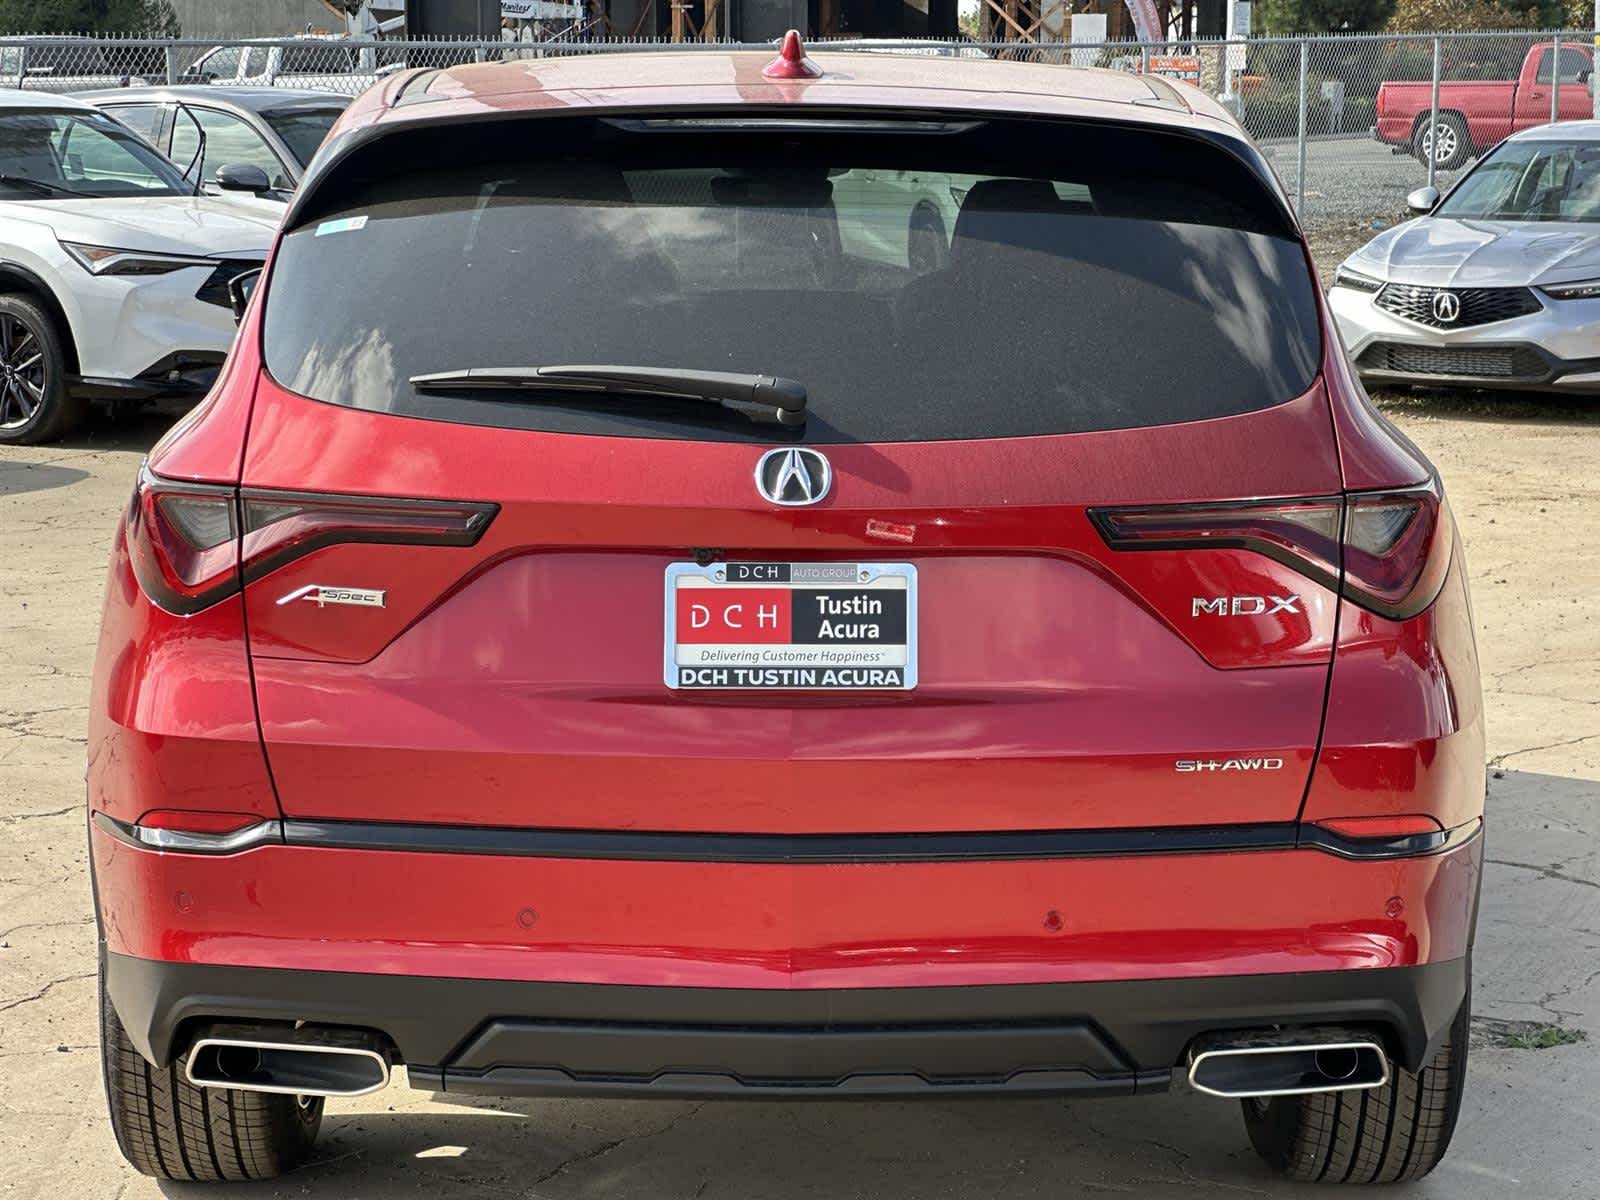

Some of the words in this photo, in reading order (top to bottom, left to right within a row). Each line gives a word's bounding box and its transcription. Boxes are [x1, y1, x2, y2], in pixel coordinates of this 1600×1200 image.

[738, 565, 778, 578] DCH
[793, 568, 821, 577] AUTO
[822, 568, 856, 577] GROUP
[815, 595, 882, 615] Tustin
[1192, 594, 1300, 616] MDX
[818, 620, 880, 639] Acura
[700, 650, 760, 664] Delivering
[762, 650, 818, 662] Customer
[821, 651, 881, 664] Happiness
[681, 669, 728, 685] DCH
[733, 669, 815, 685] TUSTIN
[821, 669, 901, 685] ACURA
